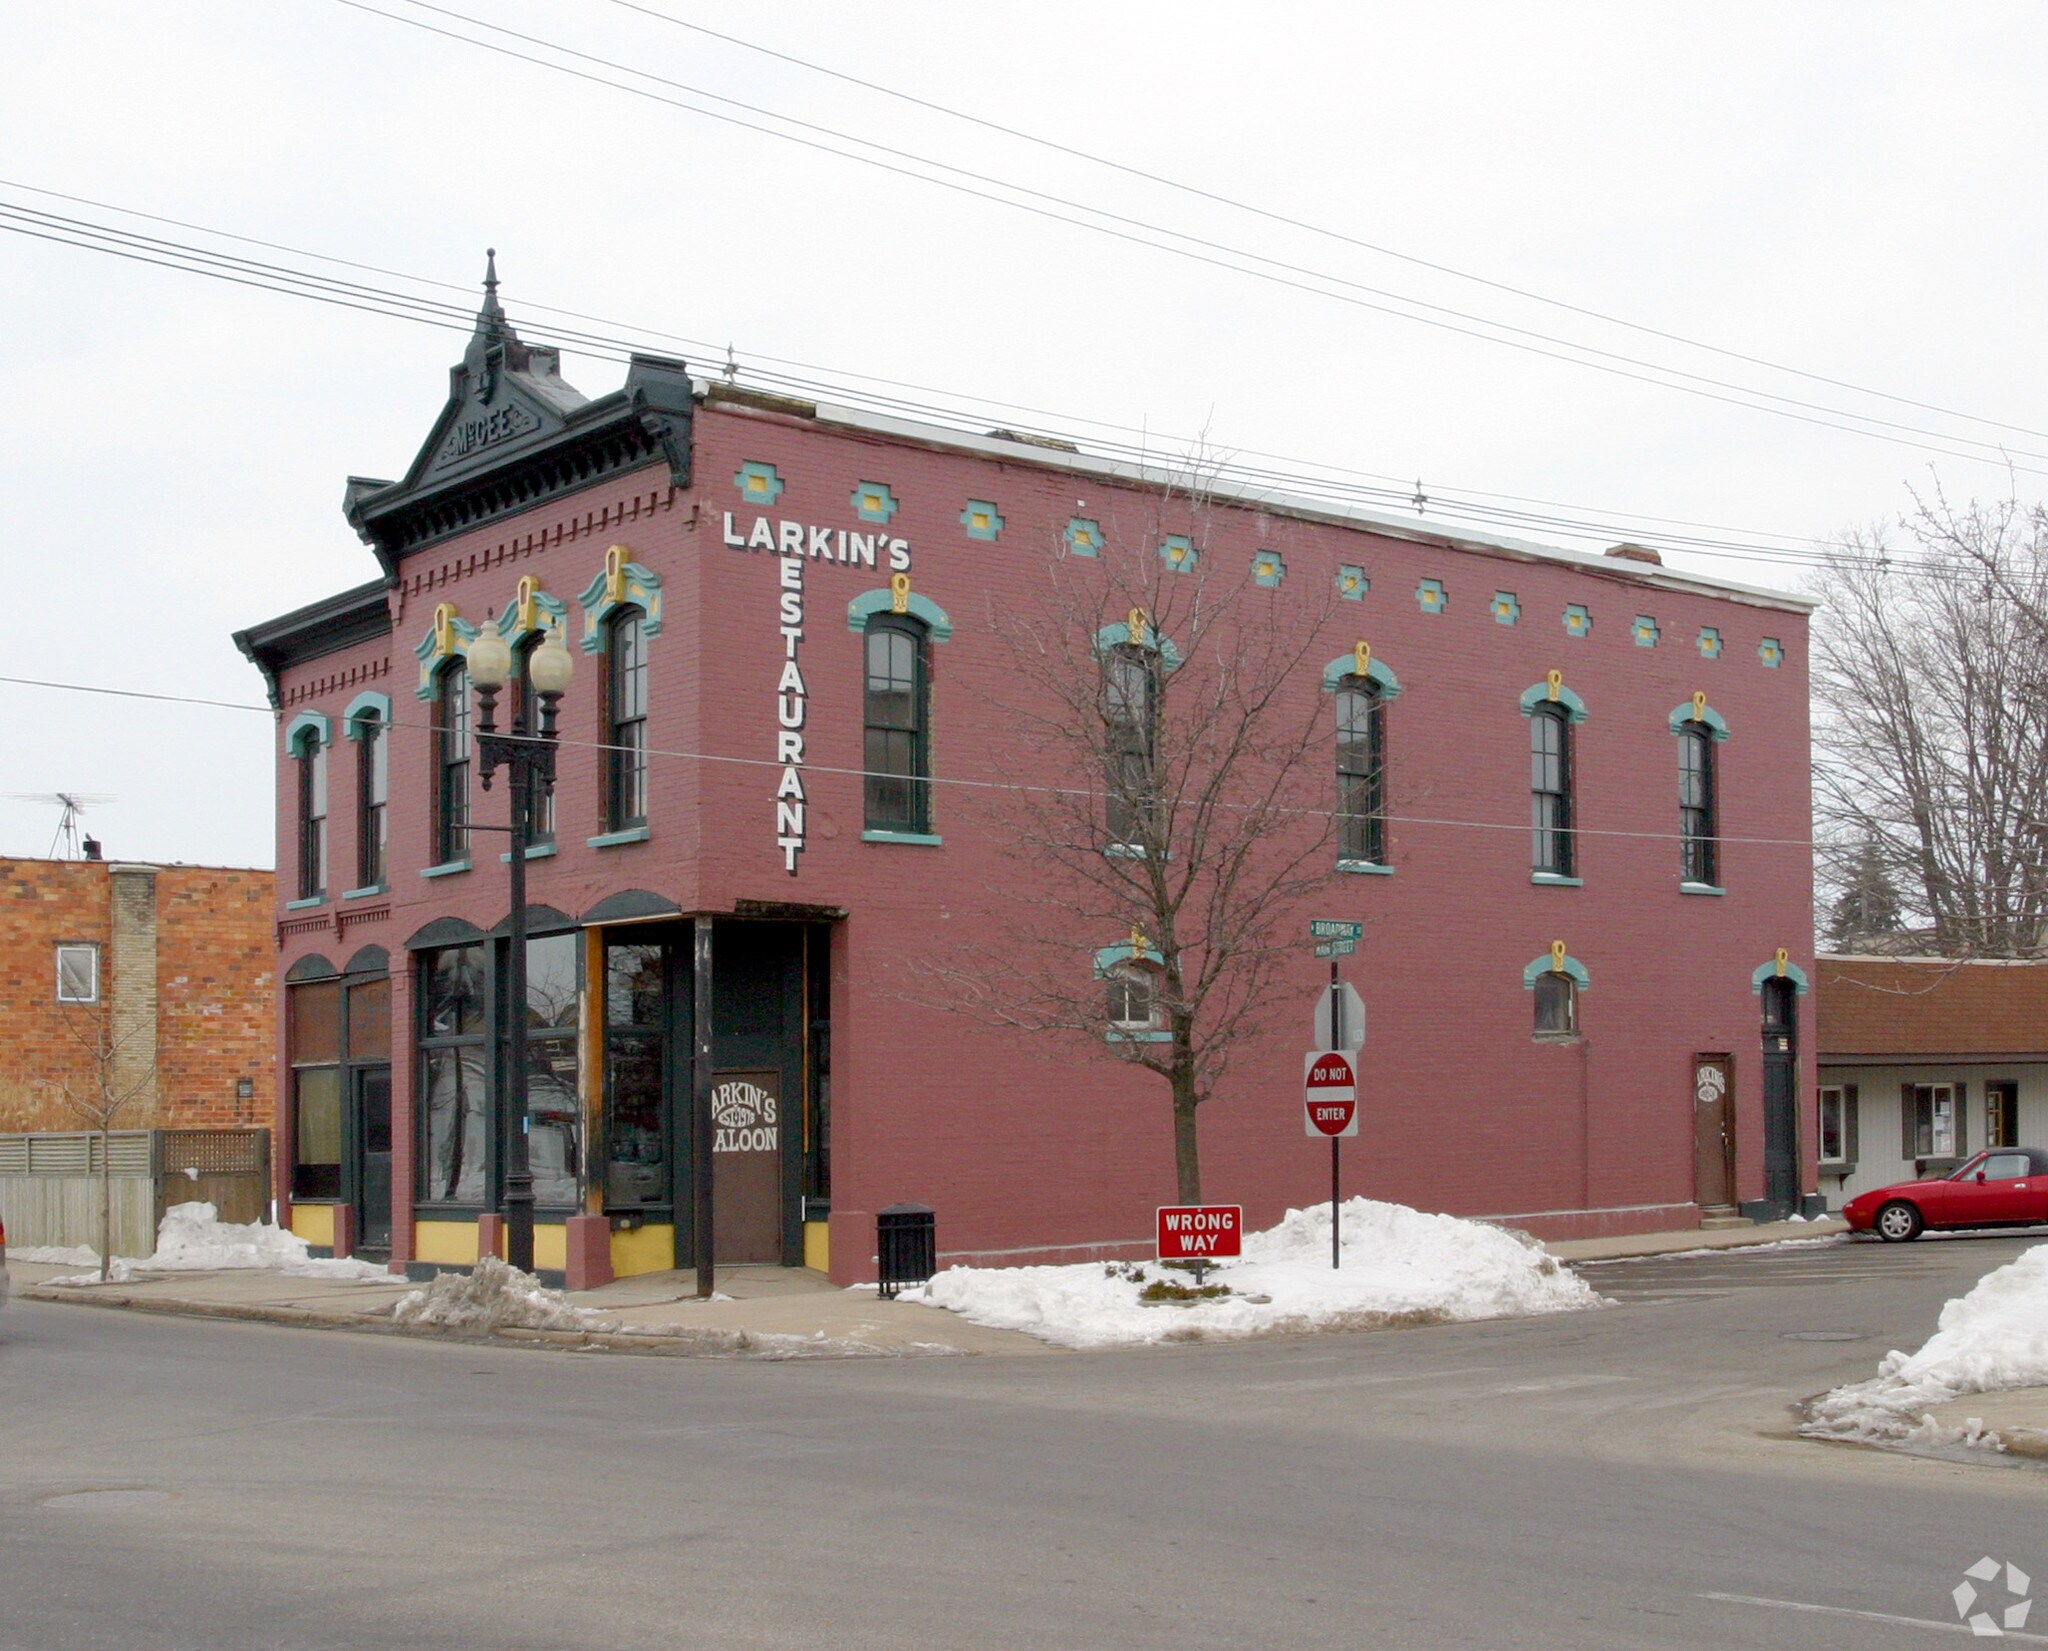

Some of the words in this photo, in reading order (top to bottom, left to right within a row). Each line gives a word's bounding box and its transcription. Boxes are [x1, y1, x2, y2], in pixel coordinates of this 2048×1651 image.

[723, 511, 911, 570] LARKIN'S
[1314, 1068, 1327, 1081] DO
[1329, 1067, 1347, 1080] NOT
[711, 1082, 777, 1124] ARKIN'S
[1317, 1107, 1346, 1121] ENTER
[712, 1127, 778, 1153] ALOON
[1165, 1213, 1234, 1231] WRONG
[1180, 1234, 1219, 1252] WAY
